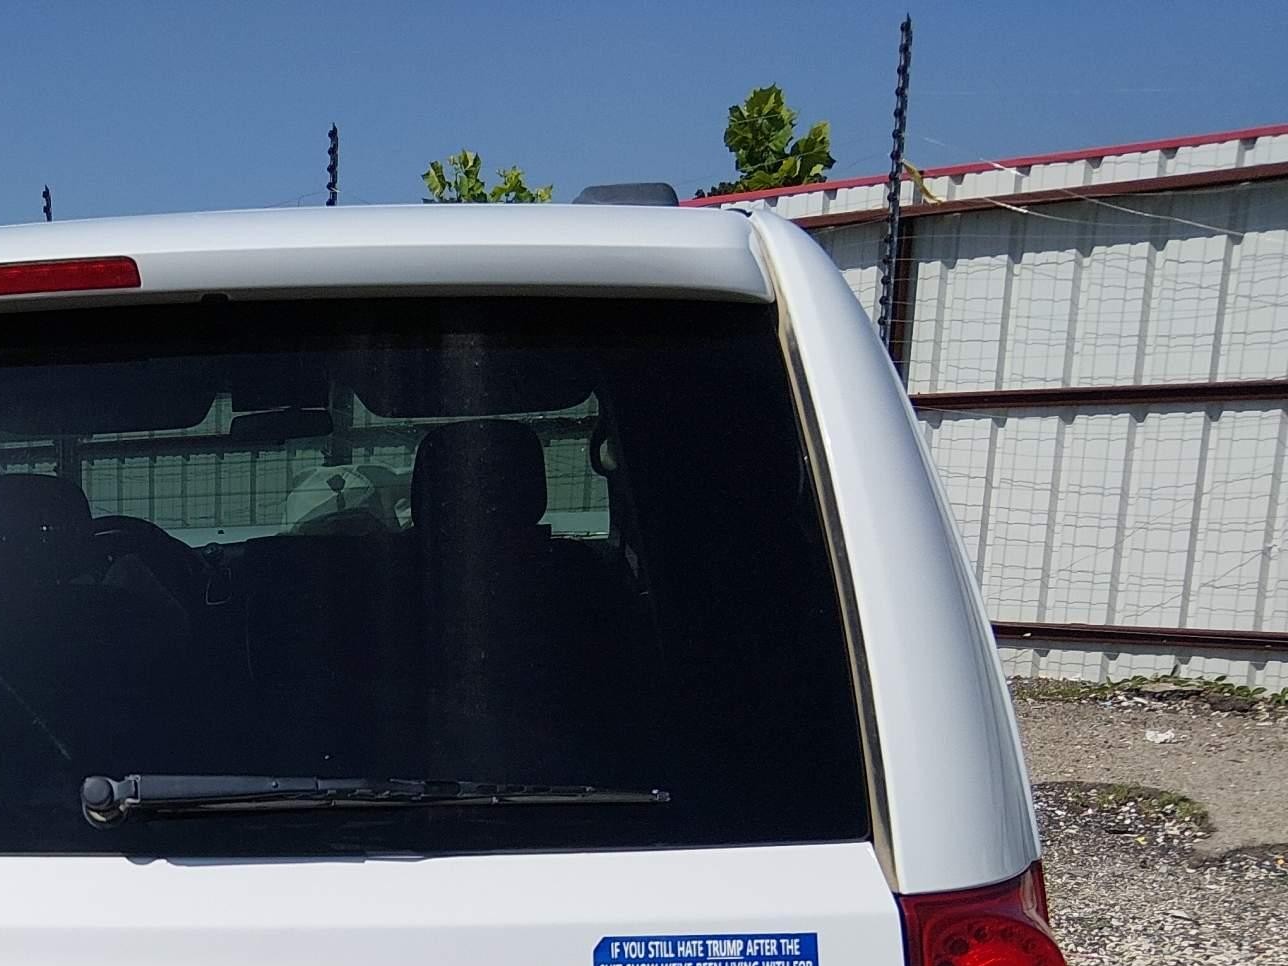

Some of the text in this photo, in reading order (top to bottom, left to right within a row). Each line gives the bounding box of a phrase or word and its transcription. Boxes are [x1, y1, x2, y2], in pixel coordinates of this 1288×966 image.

[611, 939, 800, 959] IF YOU STILL HATE TRUMP AFTER THE
